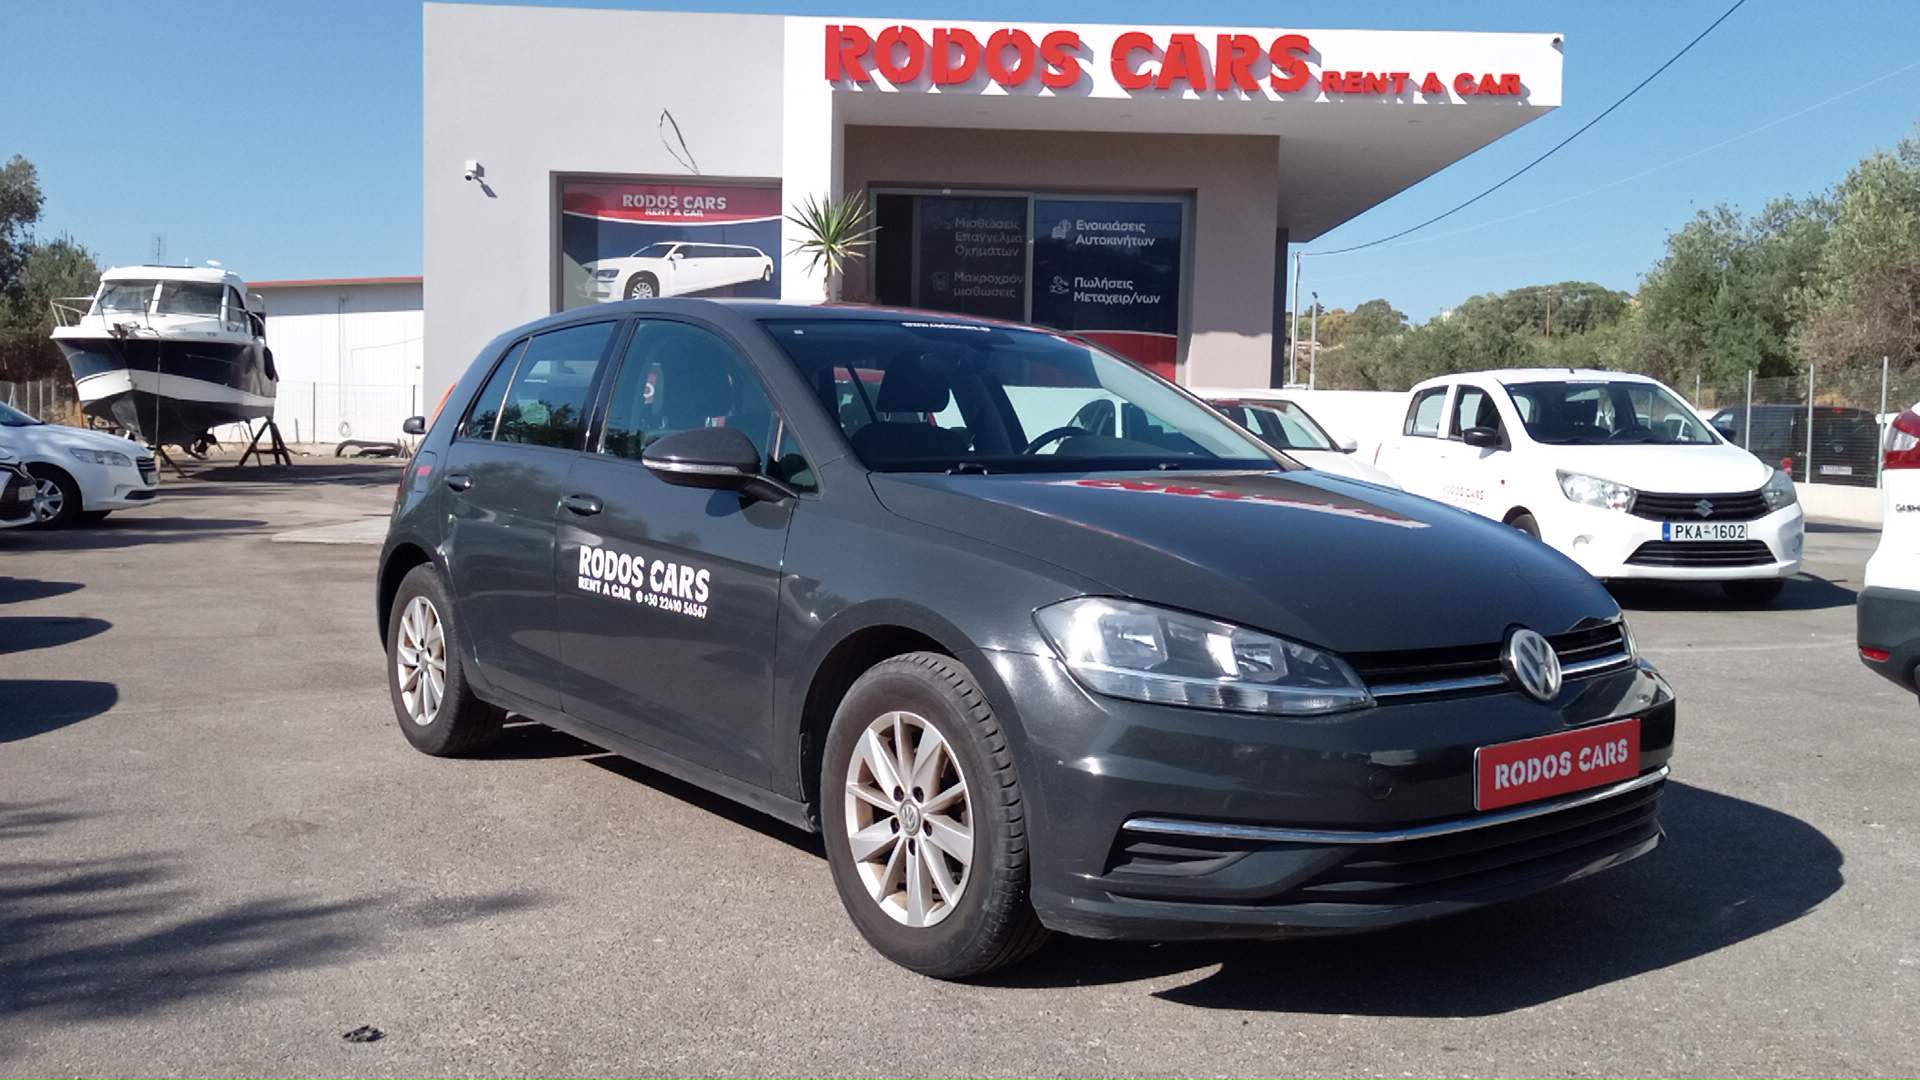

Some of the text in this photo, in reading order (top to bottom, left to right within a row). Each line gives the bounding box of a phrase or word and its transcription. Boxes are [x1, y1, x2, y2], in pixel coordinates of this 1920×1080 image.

[825, 24, 1521, 95] RODOS CARS RENT A CAR
[623, 193, 727, 210] RODOS CARS
[645, 208, 704, 217] RENT A CAR
[1076, 219, 1146, 234] Ενοικιάσεις
[1075, 234, 1156, 249] Αυτοκινήτων
[1074, 276, 1134, 290] Πωλήσεις
[1073, 290, 1161, 305] Μεταχειρ/νων
[1675, 524, 1745, 539] PKA-1602
[578, 545, 710, 602] RODOS CARS
[578, 576, 602, 593] RENT
[602, 581, 610, 595] A
[611, 584, 631, 600] CAR
[659, 595, 681, 613] 22410
[1495, 738, 1628, 790] RODOS CARS
